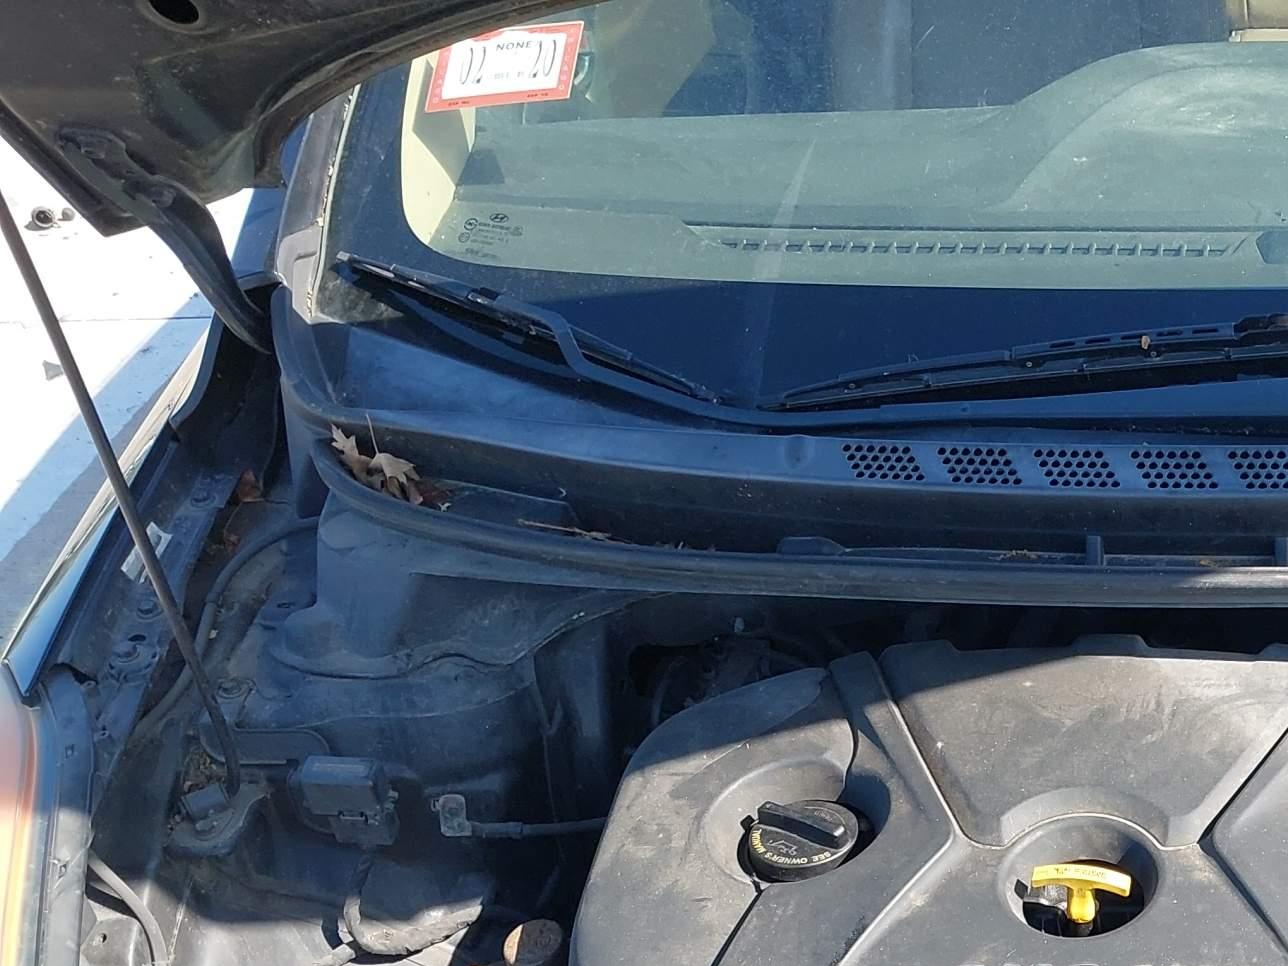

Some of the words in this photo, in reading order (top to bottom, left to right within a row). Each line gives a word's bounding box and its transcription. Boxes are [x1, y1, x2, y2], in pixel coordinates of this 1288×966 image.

[496, 41, 533, 51] NONE
[751, 829, 767, 854] MANUAL
[764, 852, 808, 865] OWNER'S
[812, 851, 831, 862] SEE
